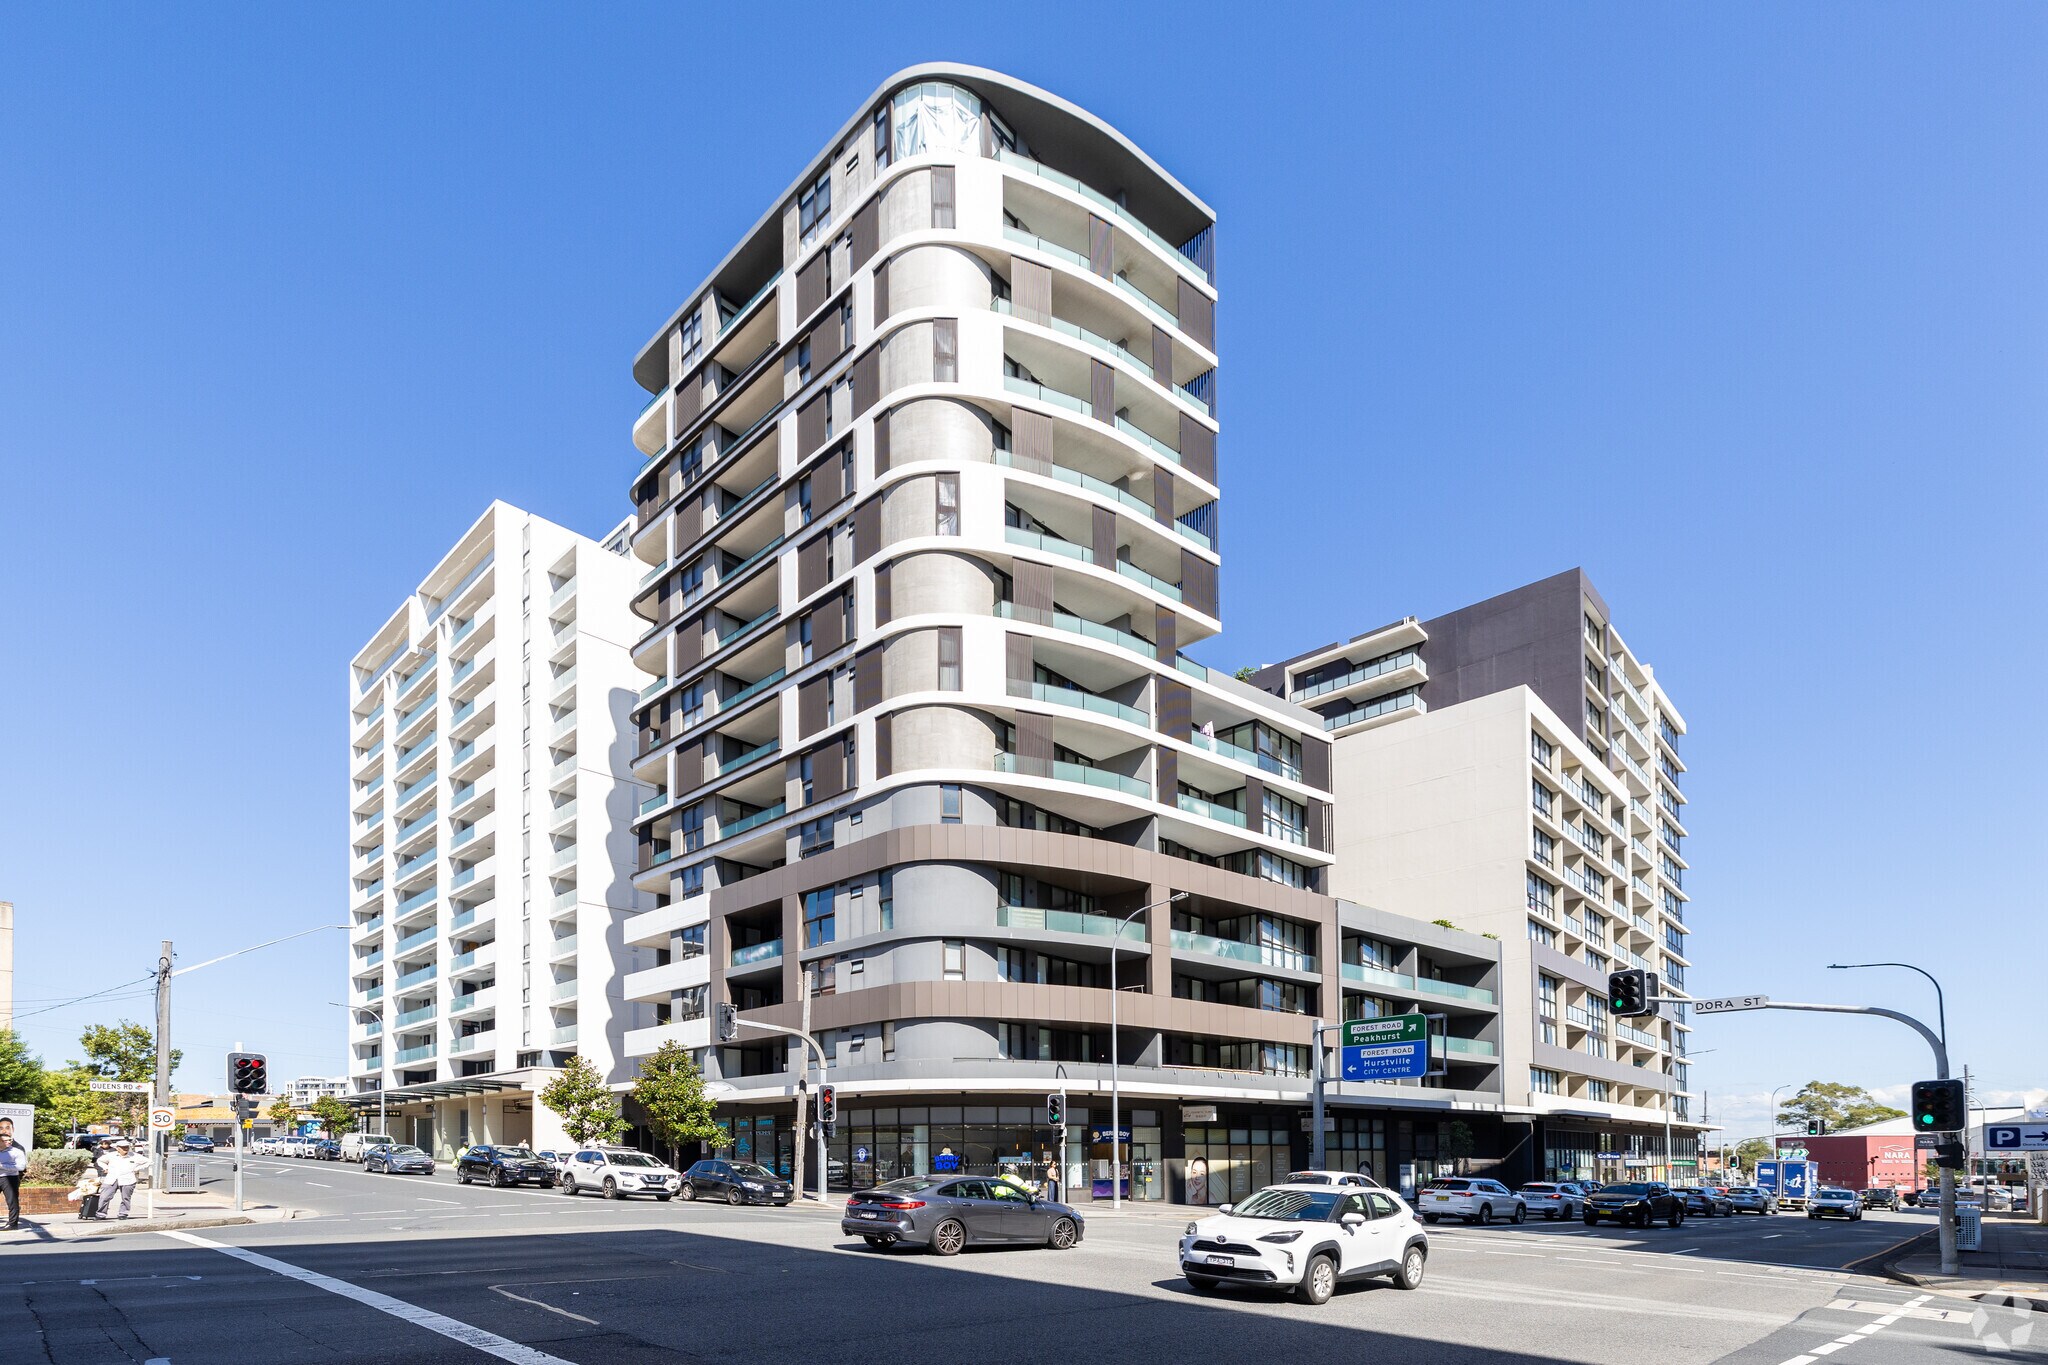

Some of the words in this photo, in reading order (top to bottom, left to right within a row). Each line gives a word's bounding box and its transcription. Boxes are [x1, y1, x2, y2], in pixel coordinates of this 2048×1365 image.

[1695, 1000, 1734, 1011] DORA
[1743, 997, 1761, 1007] ST
[1352, 1024, 1379, 1032] FOREST
[1353, 1032, 1401, 1043] Peakhurst
[1363, 1057, 1411, 1067] Hurstville
[1382, 1066, 1411, 1074] CENTRE
[91, 1082, 121, 1090] QUEENS
[154, 1114, 171, 1123] 50
[1996, 1130, 2015, 1145] P
[1884, 1151, 1911, 1159] NARA
[935, 1161, 959, 1171] BOY
